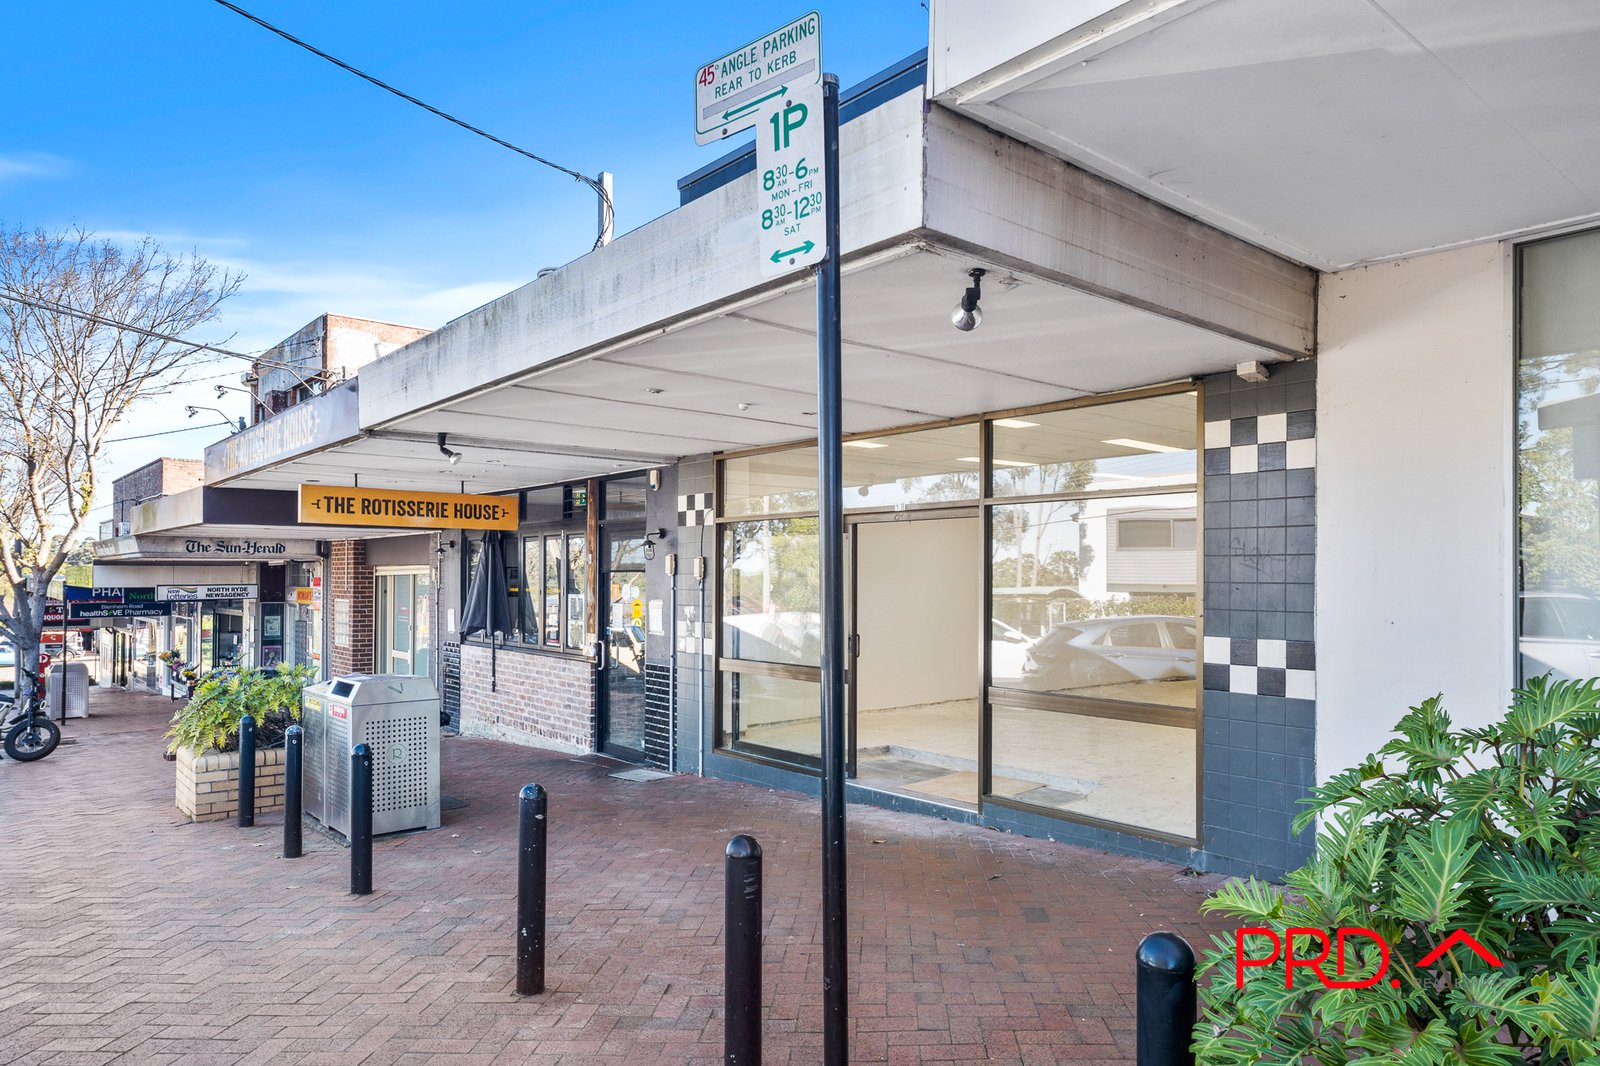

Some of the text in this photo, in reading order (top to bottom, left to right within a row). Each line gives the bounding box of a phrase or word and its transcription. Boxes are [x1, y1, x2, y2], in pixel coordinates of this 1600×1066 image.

[721, 46, 757, 78] ANGLE
[763, 17, 816, 58] PARKING
[715, 50, 797, 99] REAR TO KERB
[770, 102, 808, 152] 1P
[784, 223, 801, 237] SAT
[283, 404, 314, 451] HOUSE
[323, 496, 499, 521] THE ROTISSERIE HOUSE
[185, 539, 286, 555] The Sun-Herald
[92, 587, 122, 597] PHA
[124, 608, 163, 617] Pharmacy
